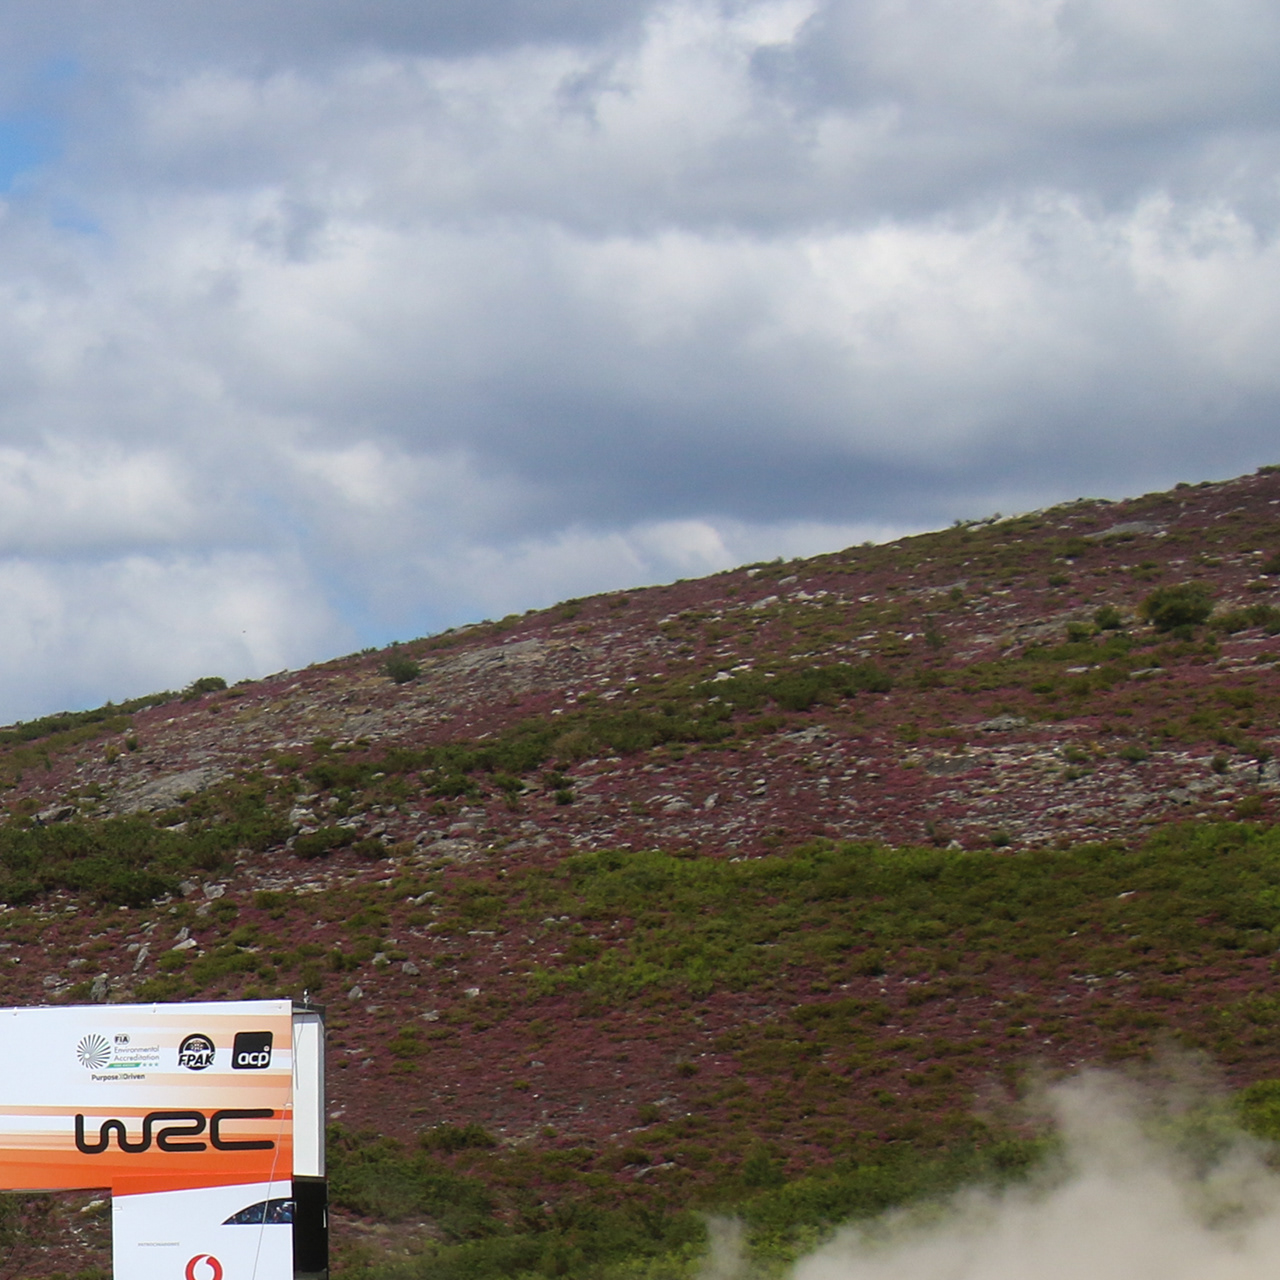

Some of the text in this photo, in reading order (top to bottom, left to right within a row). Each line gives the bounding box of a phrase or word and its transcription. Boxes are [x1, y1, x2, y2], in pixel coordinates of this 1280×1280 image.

[115, 1035, 129, 1043] FIA
[178, 1052, 216, 1067] FPAK
[237, 1051, 270, 1067] acp
[91, 1074, 119, 1082] Purpose
[75, 1108, 275, 1155] WRC
